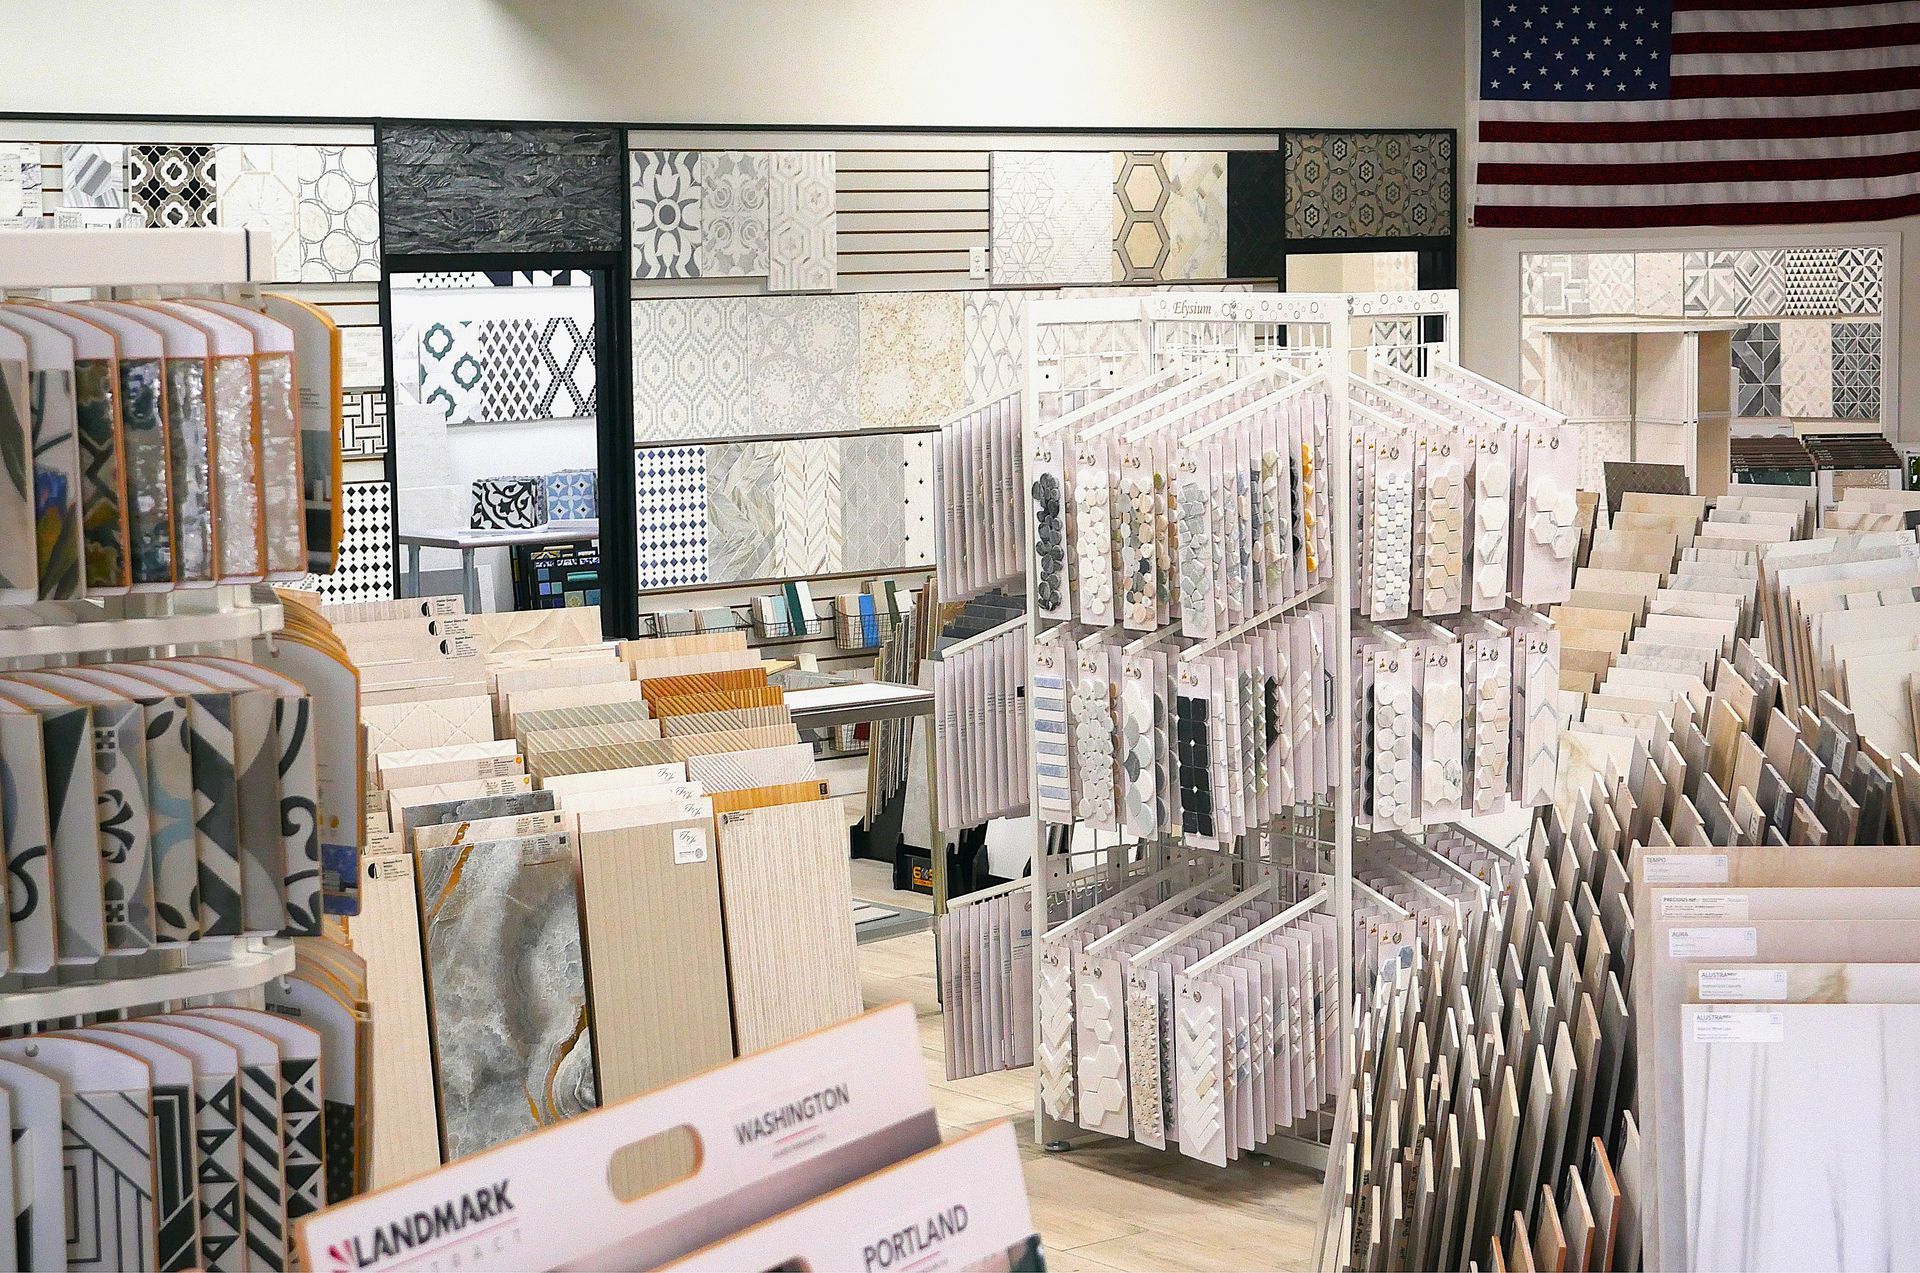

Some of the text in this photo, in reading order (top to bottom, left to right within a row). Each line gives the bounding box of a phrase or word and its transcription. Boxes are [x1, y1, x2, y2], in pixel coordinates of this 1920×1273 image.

[1173, 300, 1212, 318] Elysium
[733, 1083, 851, 1146] WASHINGTON
[353, 1178, 515, 1268] LANDMARK
[862, 1204, 970, 1273] PORTLAND
